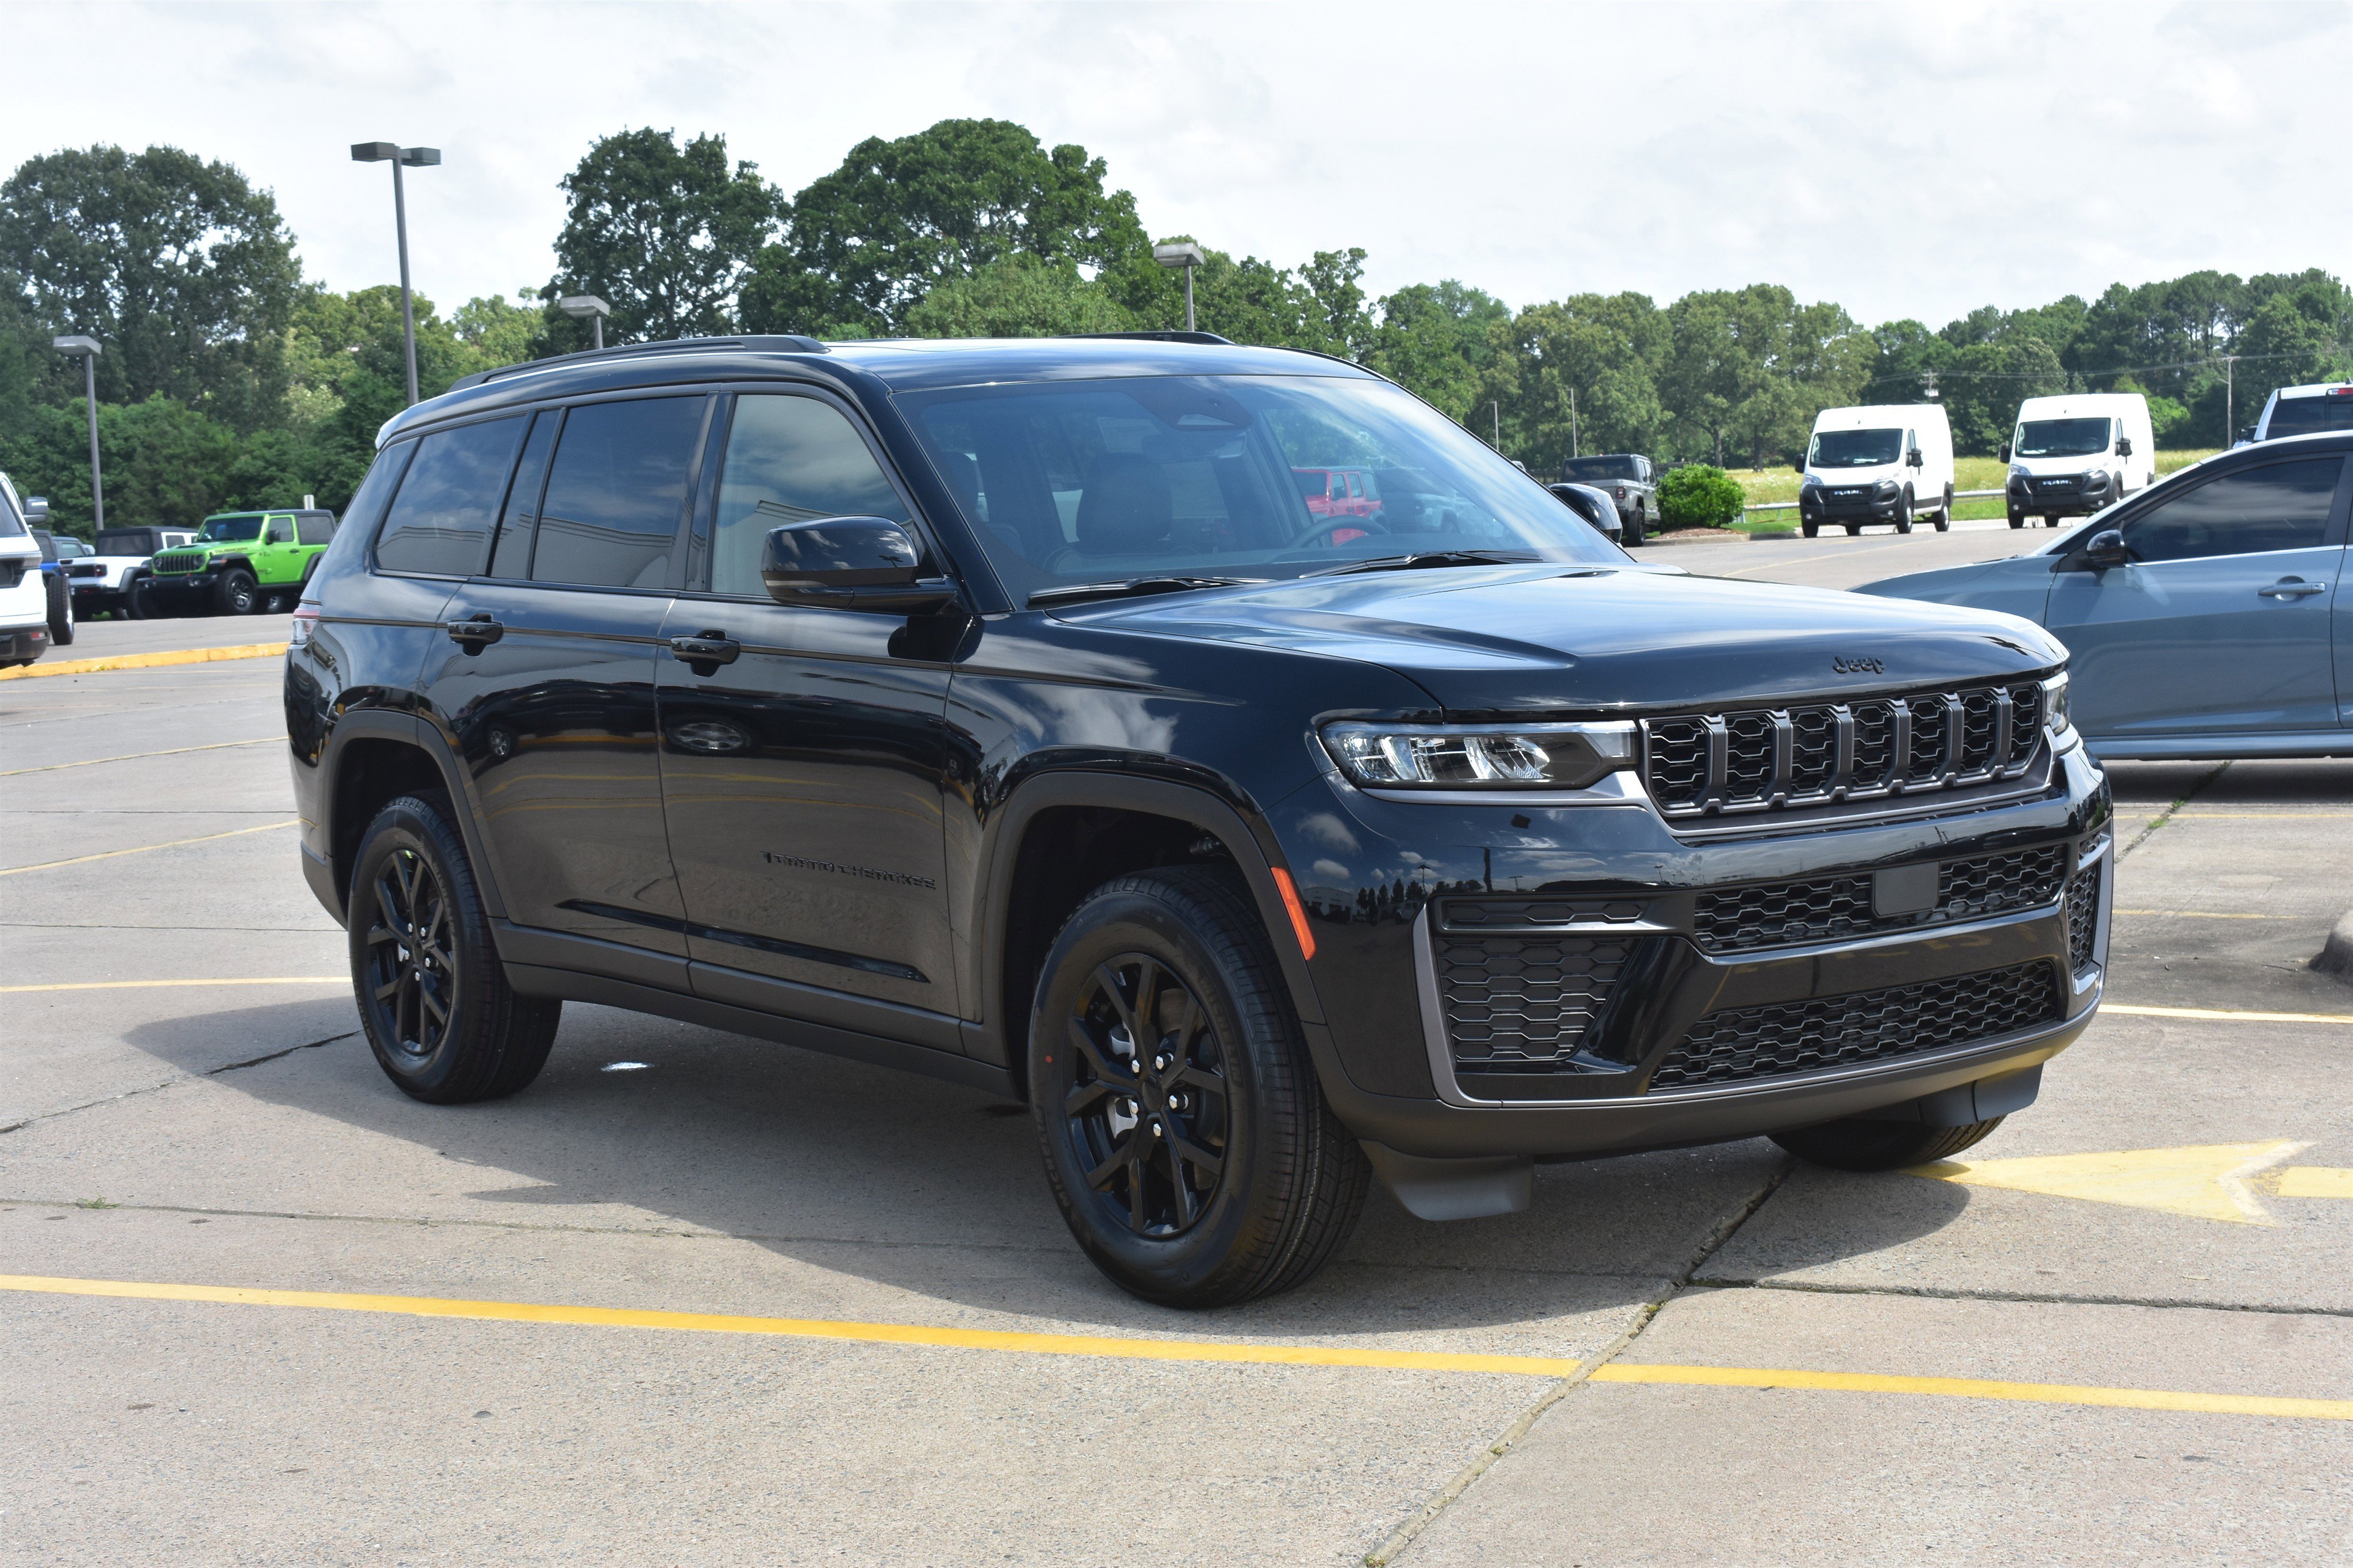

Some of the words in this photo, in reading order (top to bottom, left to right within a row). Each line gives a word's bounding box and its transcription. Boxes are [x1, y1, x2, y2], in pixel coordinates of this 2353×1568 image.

[1832, 655, 1885, 675] Jeep
[773, 854, 835, 873] GRAND
[838, 863, 936, 890] CHEROKEE
